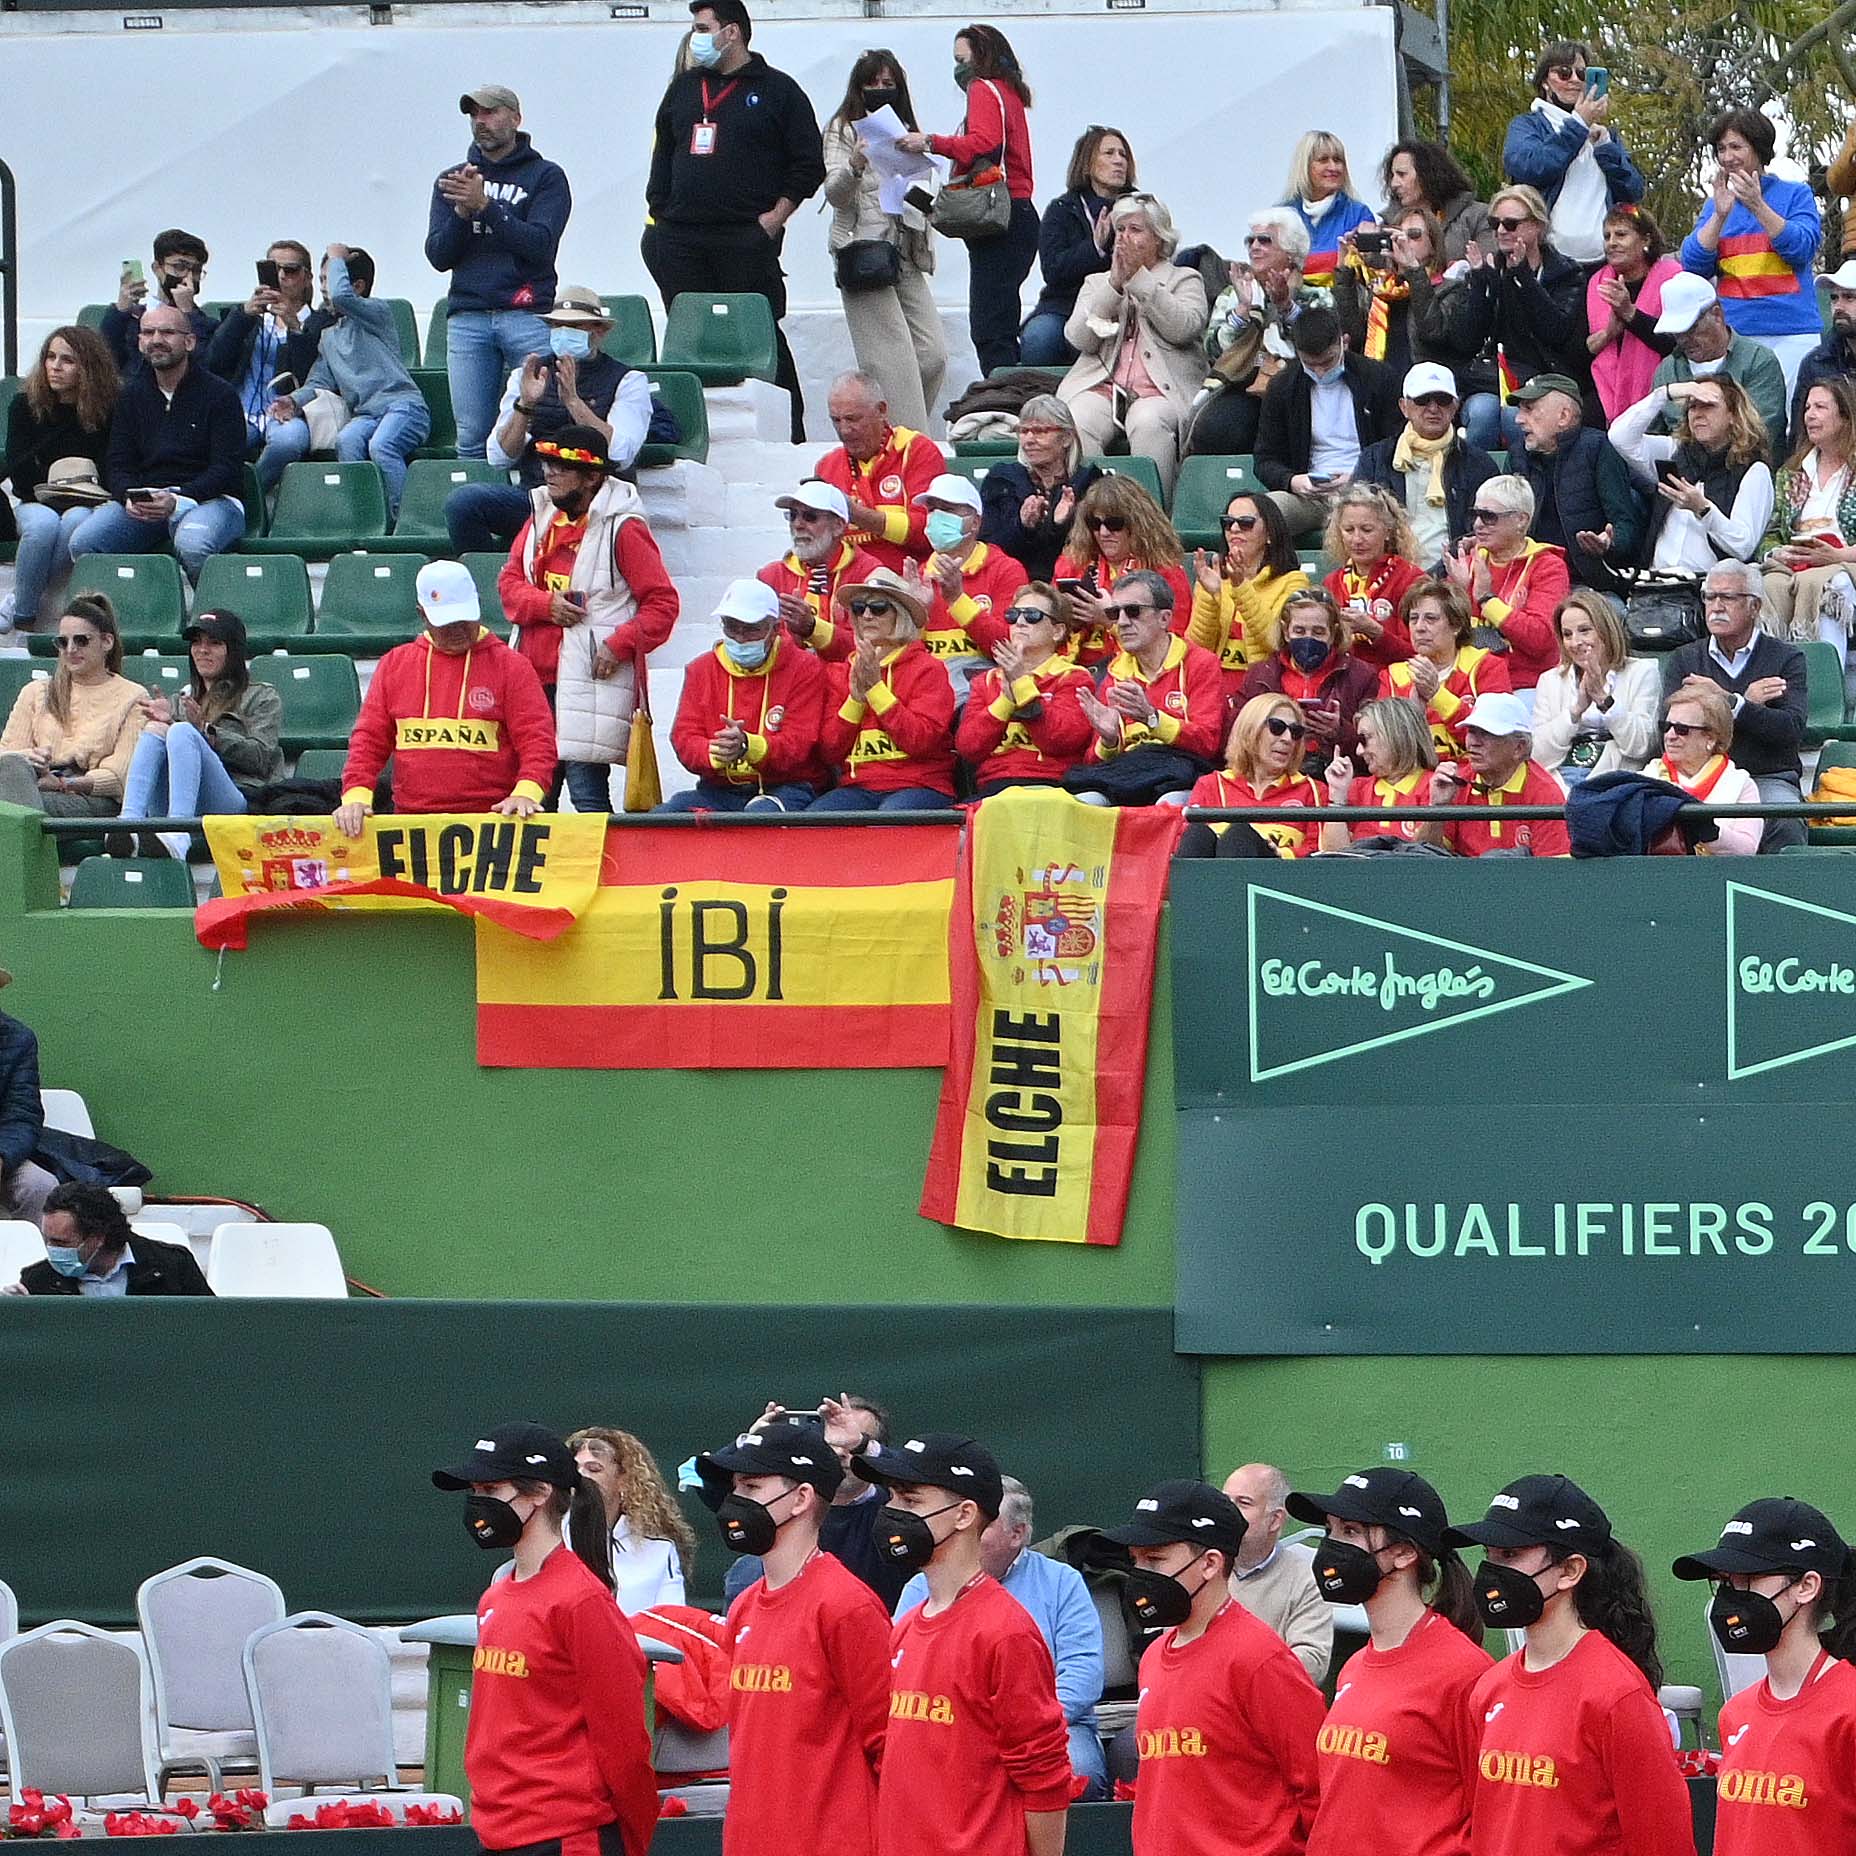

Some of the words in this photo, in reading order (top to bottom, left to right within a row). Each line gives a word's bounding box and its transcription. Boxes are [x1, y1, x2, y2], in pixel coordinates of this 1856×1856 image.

[483, 180, 529, 205] MMY
[404, 725, 488, 745] ESPAÑA
[1261, 958, 1296, 996] El
[1297, 960, 1377, 996] Corte
[1379, 951, 1496, 1011] Inglés
[1739, 955, 1775, 994] El
[1775, 957, 1855, 994] Corte
[983, 1008, 1063, 1198] ELCHE
[1354, 1200, 1775, 1265] QUALIFIERS
[1388, 1447, 1405, 1460] 10
[472, 1646, 529, 1678] oma
[730, 1663, 793, 1692] oma
[1138, 1726, 1209, 1761] oma
[1316, 1723, 1390, 1766] oma
[1477, 1748, 1560, 1790] oma
[1717, 1767, 1809, 1809] oma
